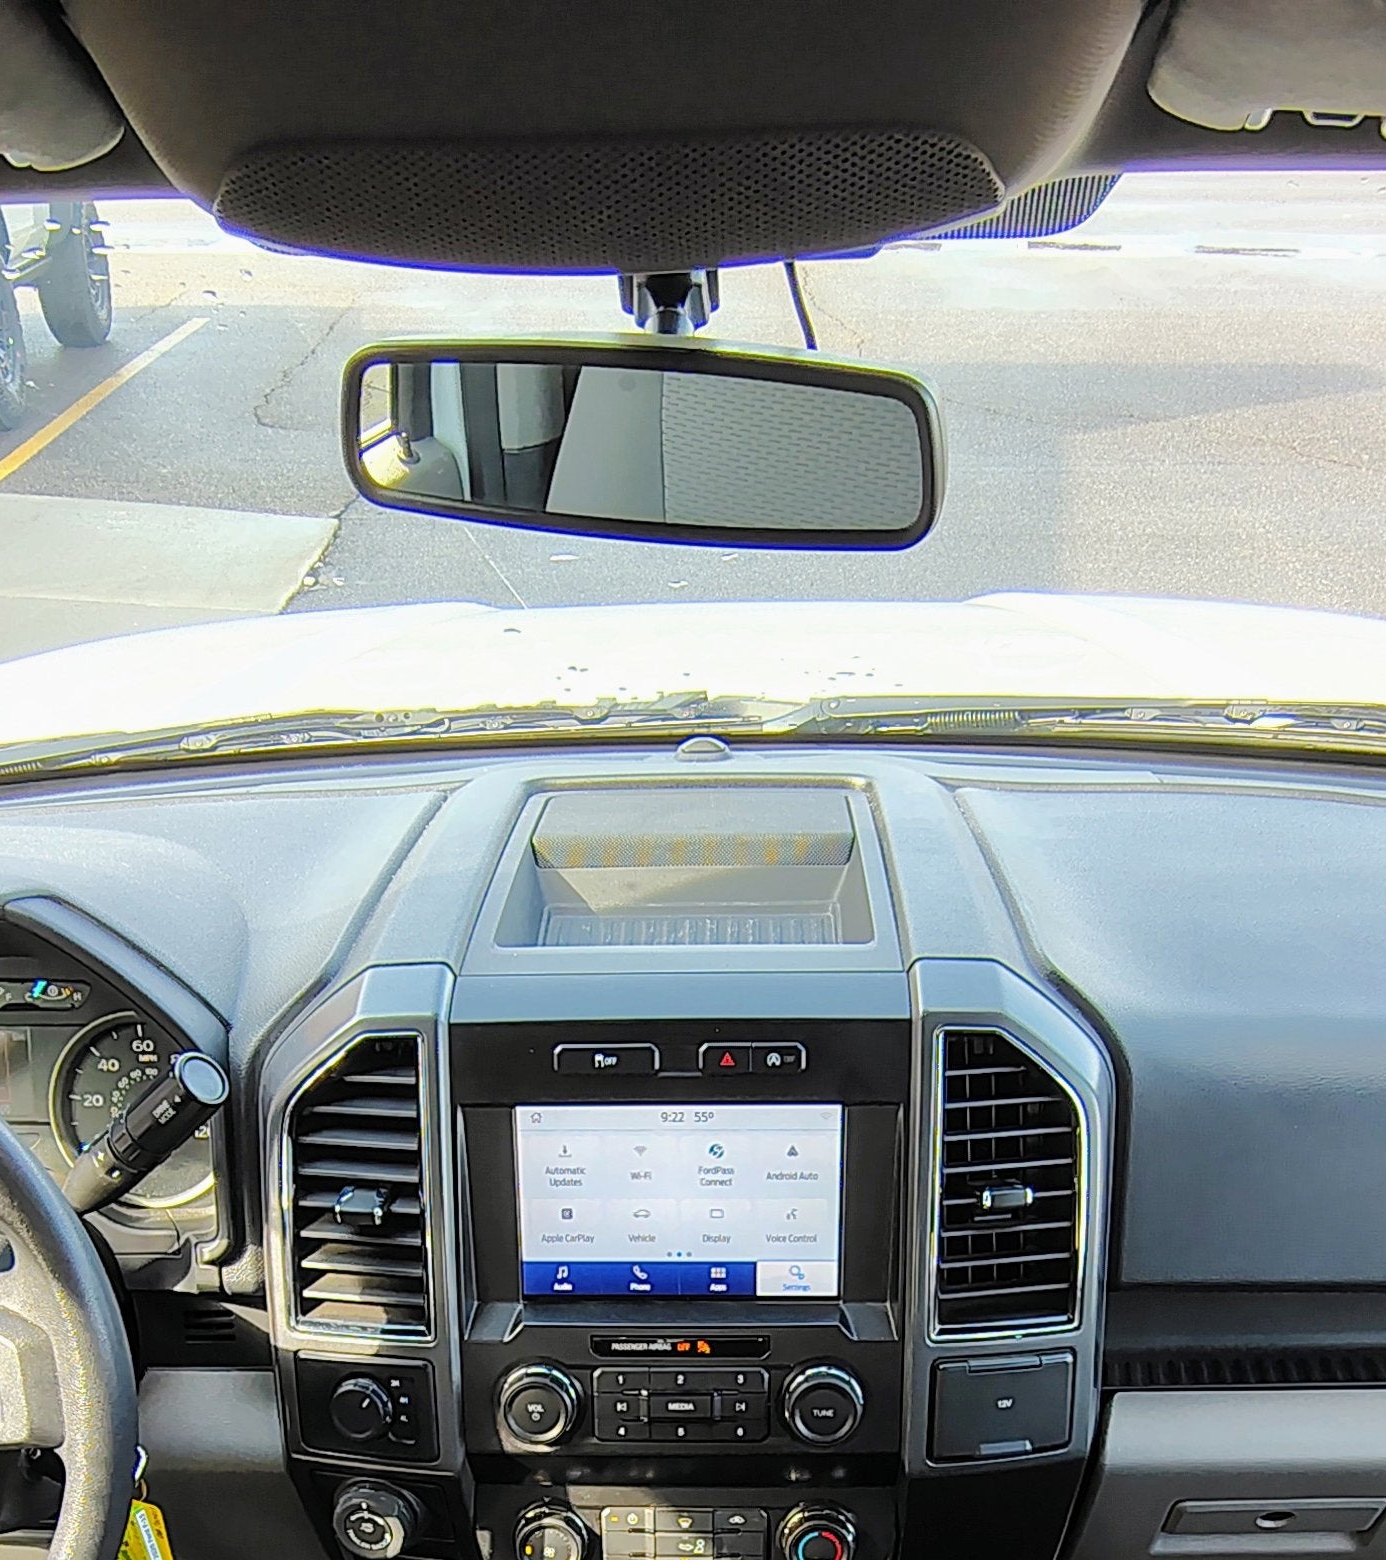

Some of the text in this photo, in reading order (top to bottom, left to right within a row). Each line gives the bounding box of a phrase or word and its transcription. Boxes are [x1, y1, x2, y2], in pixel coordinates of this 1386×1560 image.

[132, 1040, 154, 1052] 60
[138, 1054, 158, 1062] MPH
[604, 1056, 618, 1066] OFF
[97, 1059, 119, 1072] 40
[83, 1094, 104, 1107] 20
[660, 1111, 685, 1123] 9:22
[544, 1166, 587, 1176] Automatic
[697, 1165, 735, 1175] FordPass
[630, 1171, 653, 1181] Wi-Fi
[765, 1171, 819, 1181] Android Auto
[549, 1178, 583, 1188] Updates
[699, 1177, 733, 1187] Connect
[541, 1233, 595, 1244] Apple CarPlay
[627, 1233, 656, 1243] Vehicle
[701, 1233, 731, 1244] Display
[765, 1233, 818, 1243] Voice Control
[553, 1283, 573, 1291] Audio
[629, 1282, 651, 1292] Phone
[709, 1282, 727, 1293] Apps
[782, 1282, 811, 1292] Settings
[611, 1342, 648, 1351] PASSENGER
[676, 1342, 691, 1352] OFF
[617, 1374, 625, 1385] 1
[676, 1374, 685, 1385] 2
[736, 1374, 744, 1384] 3
[527, 1403, 545, 1413] VOL
[667, 1402, 695, 1411] MEDIA
[997, 1398, 1013, 1408] 12V
[812, 1409, 834, 1418] TUNE
[618, 1427, 626, 1436] 4
[677, 1427, 685, 1436] 5
[736, 1427, 744, 1436] 6
